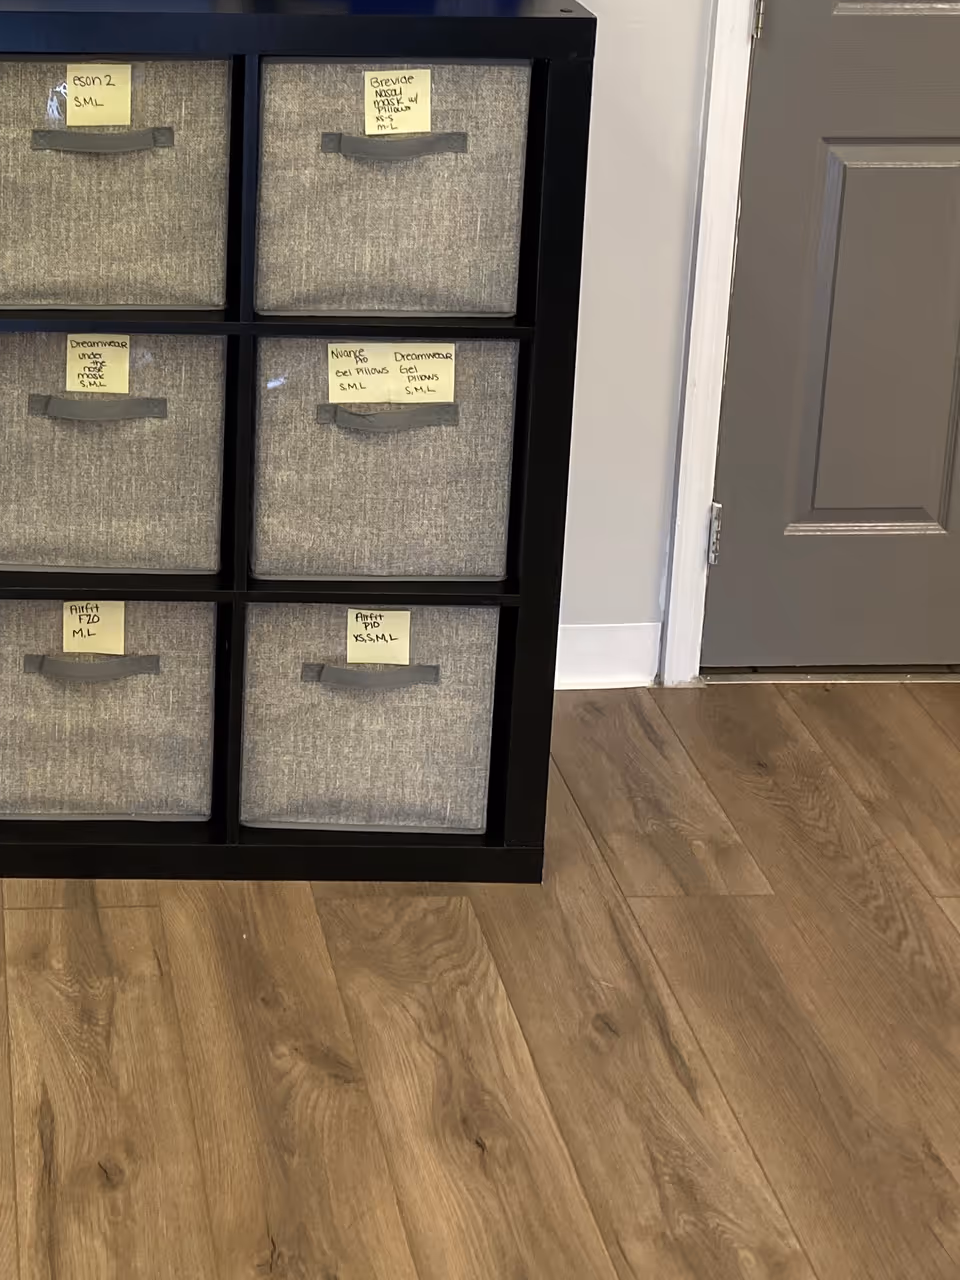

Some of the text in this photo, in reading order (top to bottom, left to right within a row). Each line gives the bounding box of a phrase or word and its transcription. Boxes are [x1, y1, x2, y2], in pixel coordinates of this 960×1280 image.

[72, 74, 116, 88] eson 2
[375, 86, 402, 98] Nasal
